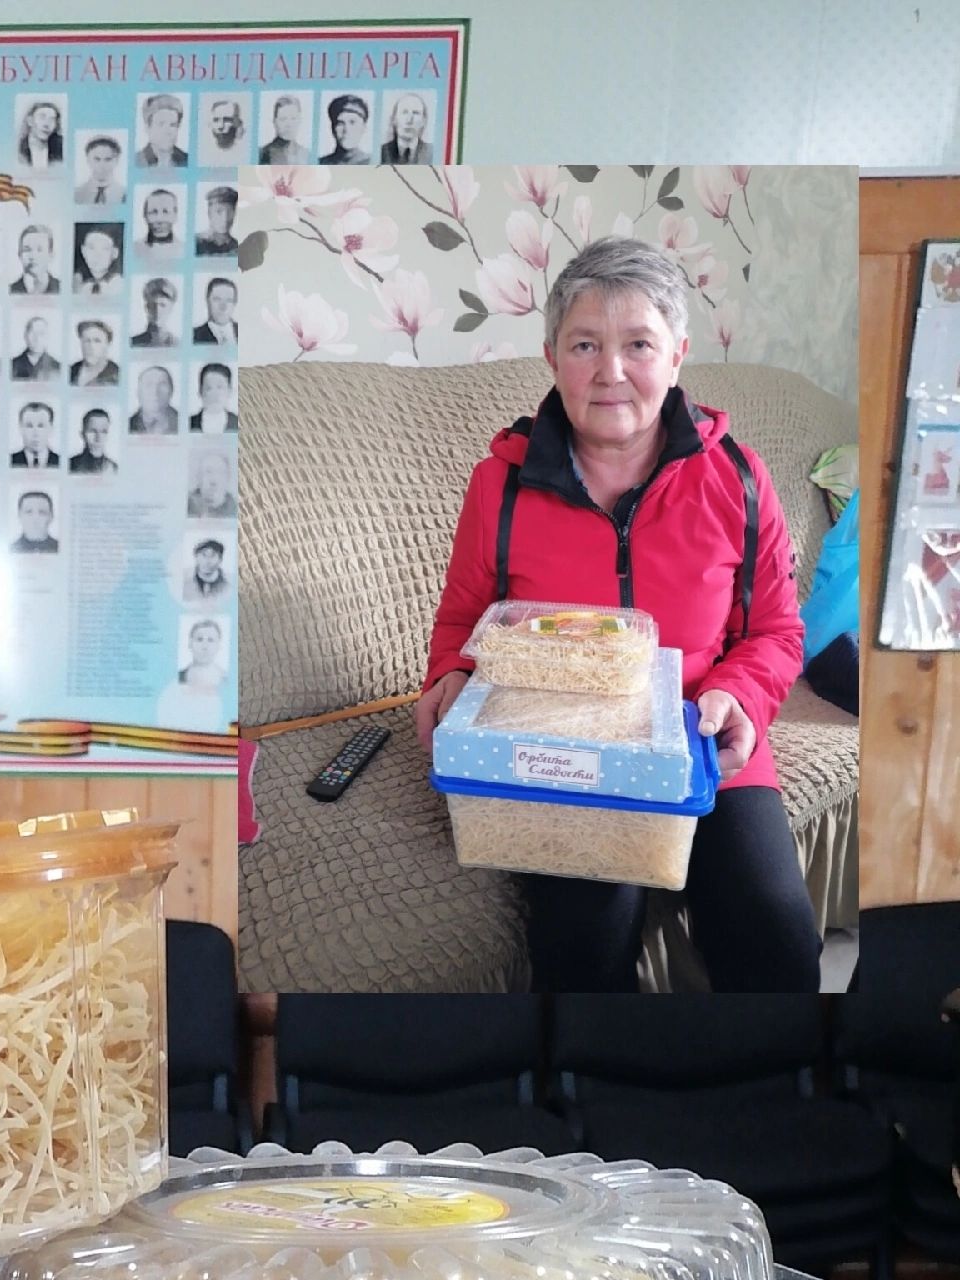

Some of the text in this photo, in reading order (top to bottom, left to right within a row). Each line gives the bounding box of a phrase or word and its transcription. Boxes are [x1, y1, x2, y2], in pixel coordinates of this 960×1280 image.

[0, 53, 128, 84] БУЛГАН
[140, 51, 441, 83] АВЫЛДАШЛАРГА
[529, 765, 594, 780] Сладости
